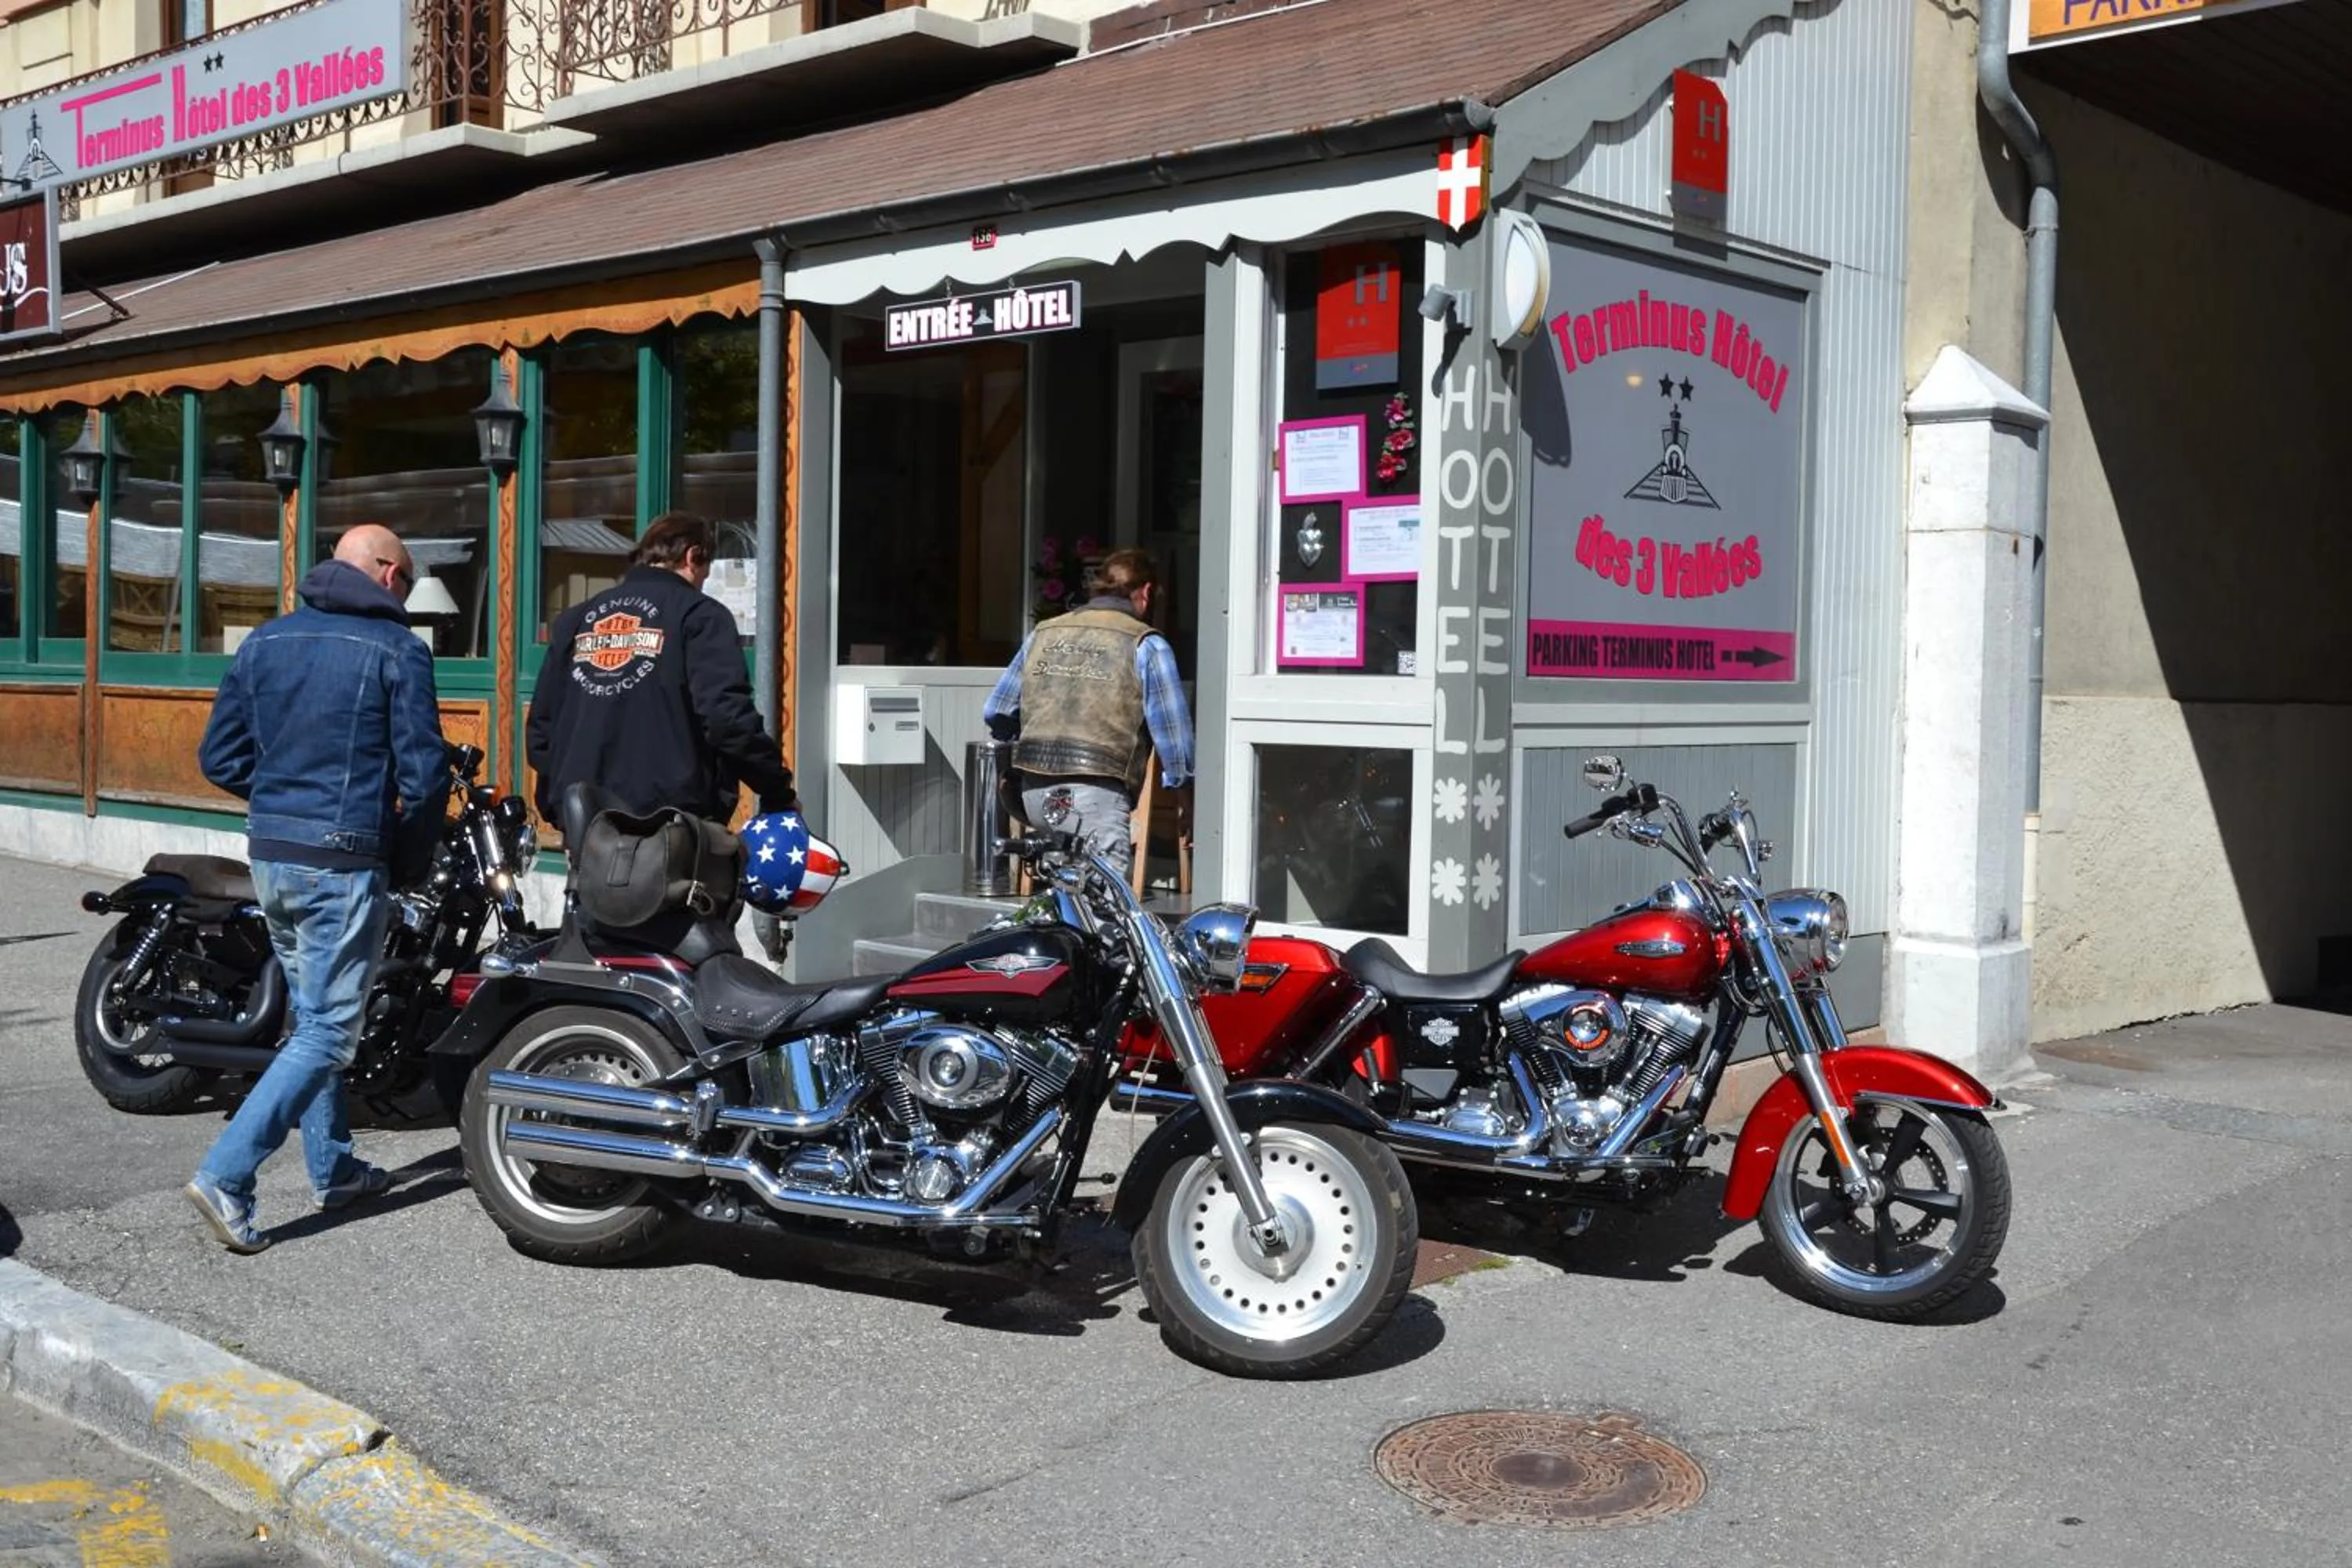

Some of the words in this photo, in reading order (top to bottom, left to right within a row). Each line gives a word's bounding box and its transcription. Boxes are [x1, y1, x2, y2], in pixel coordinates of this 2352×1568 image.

[60, 74, 162, 169] Terminus
[172, 64, 227, 144] Hôtel
[231, 82, 272, 126] des
[276, 68, 289, 113] 3
[294, 45, 384, 108] Vallées
[1699, 100, 1721, 144] H
[1355, 262, 1388, 304] H
[889, 298, 973, 346] ENTRÉE
[994, 288, 1072, 332] HÔTEL
[1549, 289, 1707, 374] Terminus
[1711, 308, 1789, 414] Hôtel
[1575, 514, 1633, 587] des
[1635, 537, 1656, 595] 3
[1661, 534, 1762, 600] Vallées
[1533, 632, 1599, 667] PARKING
[1602, 636, 1674, 670] TERMINUS
[1676, 639, 1716, 672] HOTEL
[572, 660, 655, 696] MOTORCYCLES
